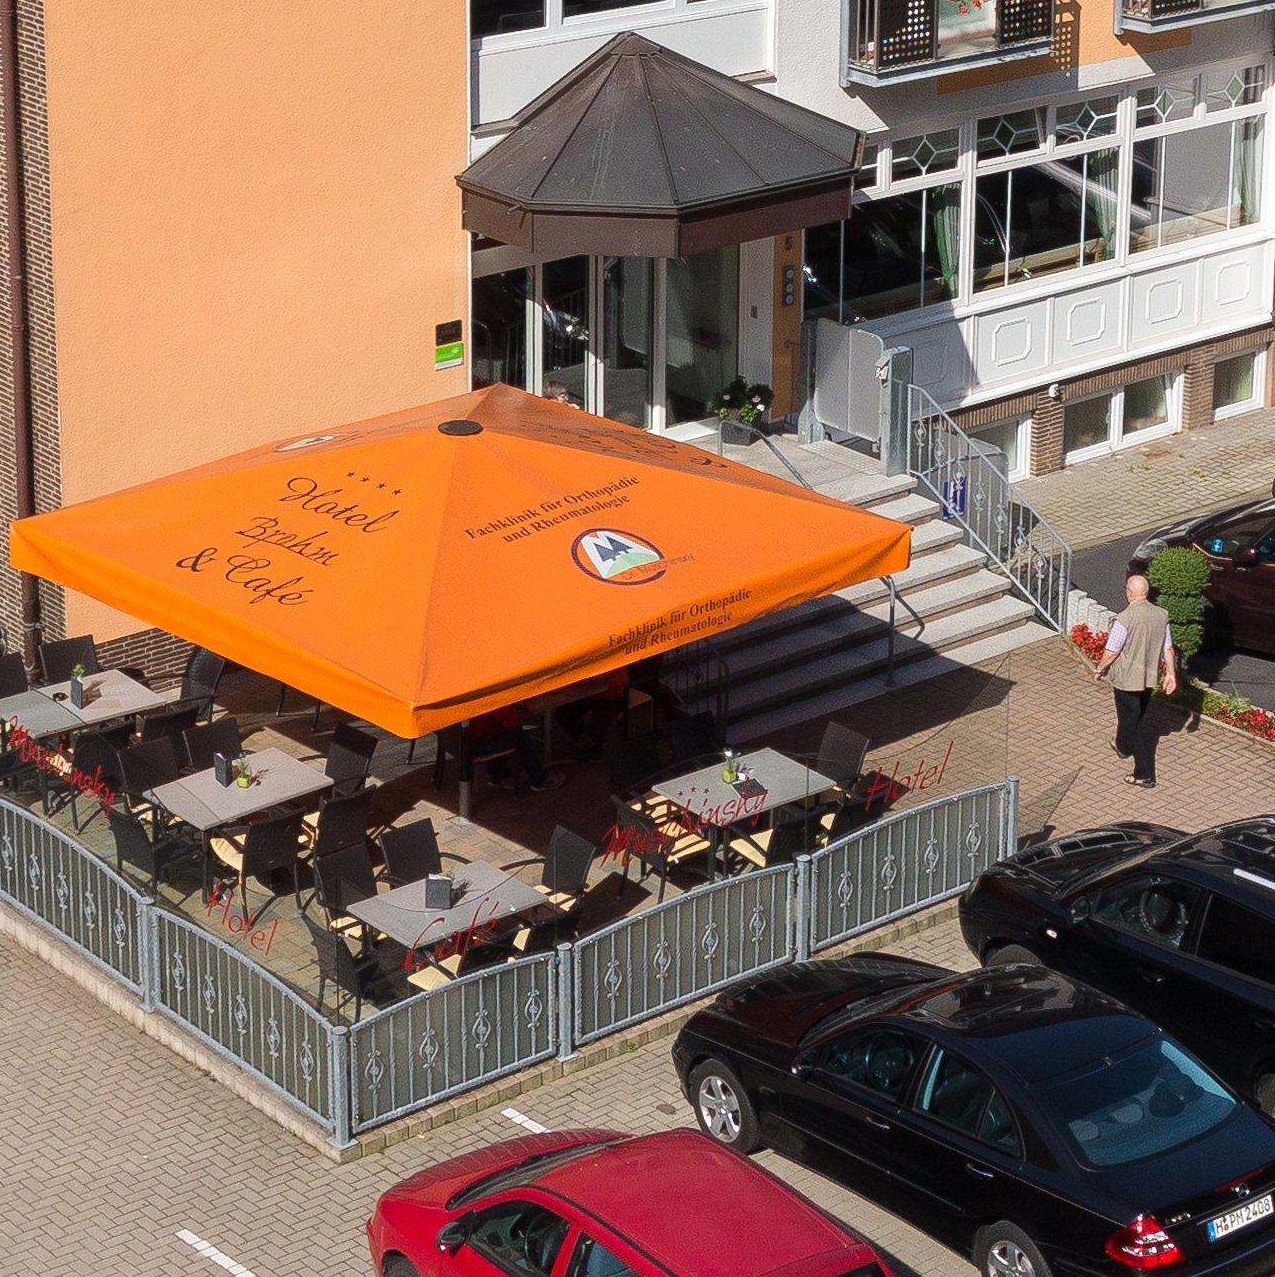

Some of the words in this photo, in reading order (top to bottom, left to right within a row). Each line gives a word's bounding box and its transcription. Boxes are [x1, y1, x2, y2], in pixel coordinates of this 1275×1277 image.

[278, 476, 400, 534] Hotel
[464, 508, 541, 540] Fachklinik
[540, 500, 563, 514] für
[563, 475, 640, 506] Orthopädie
[502, 526, 531, 543] und
[530, 494, 631, 532] Rheumatologie
[175, 547, 218, 573] &
[225, 554, 314, 606] Café
[608, 616, 668, 648] Fachklinik
[669, 610, 688, 624] für
[689, 587, 753, 618] Orthopädie
[625, 636, 647, 655] und
[650, 609, 734, 646] Rheumatologie
[865, 740, 954, 811] Hotel
[207, 882, 279, 956] Hotel
[1215, 1221, 1224, 1234] H
[1245, 1198, 1271, 1222] 2408
